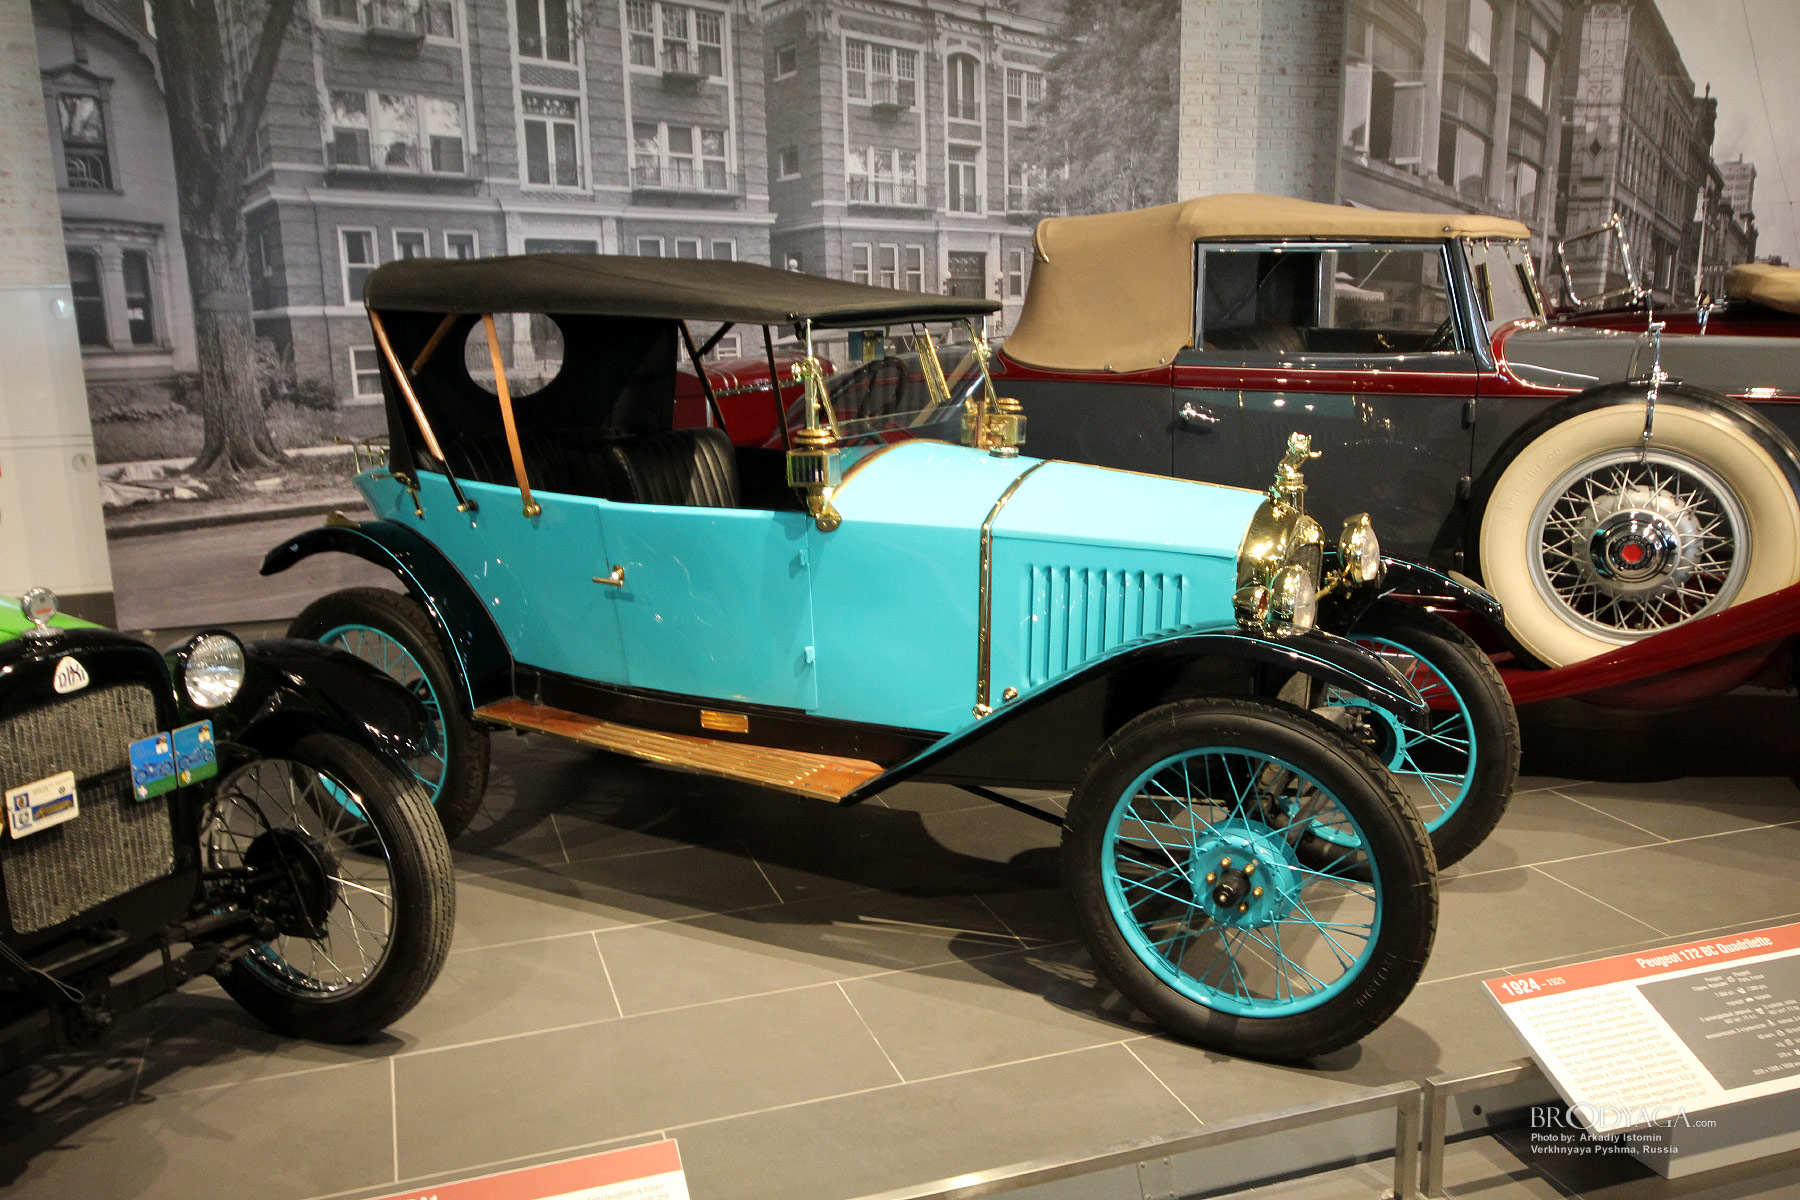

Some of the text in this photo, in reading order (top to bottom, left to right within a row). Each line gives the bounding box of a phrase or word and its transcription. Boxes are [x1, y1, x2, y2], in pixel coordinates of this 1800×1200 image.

[57, 663, 86, 688] DIXI
[1636, 935, 1773, 970] Peugeot 172 BC Quadrilette
[1501, 976, 1541, 997] 1924
[1546, 975, 1566, 988] 1925
